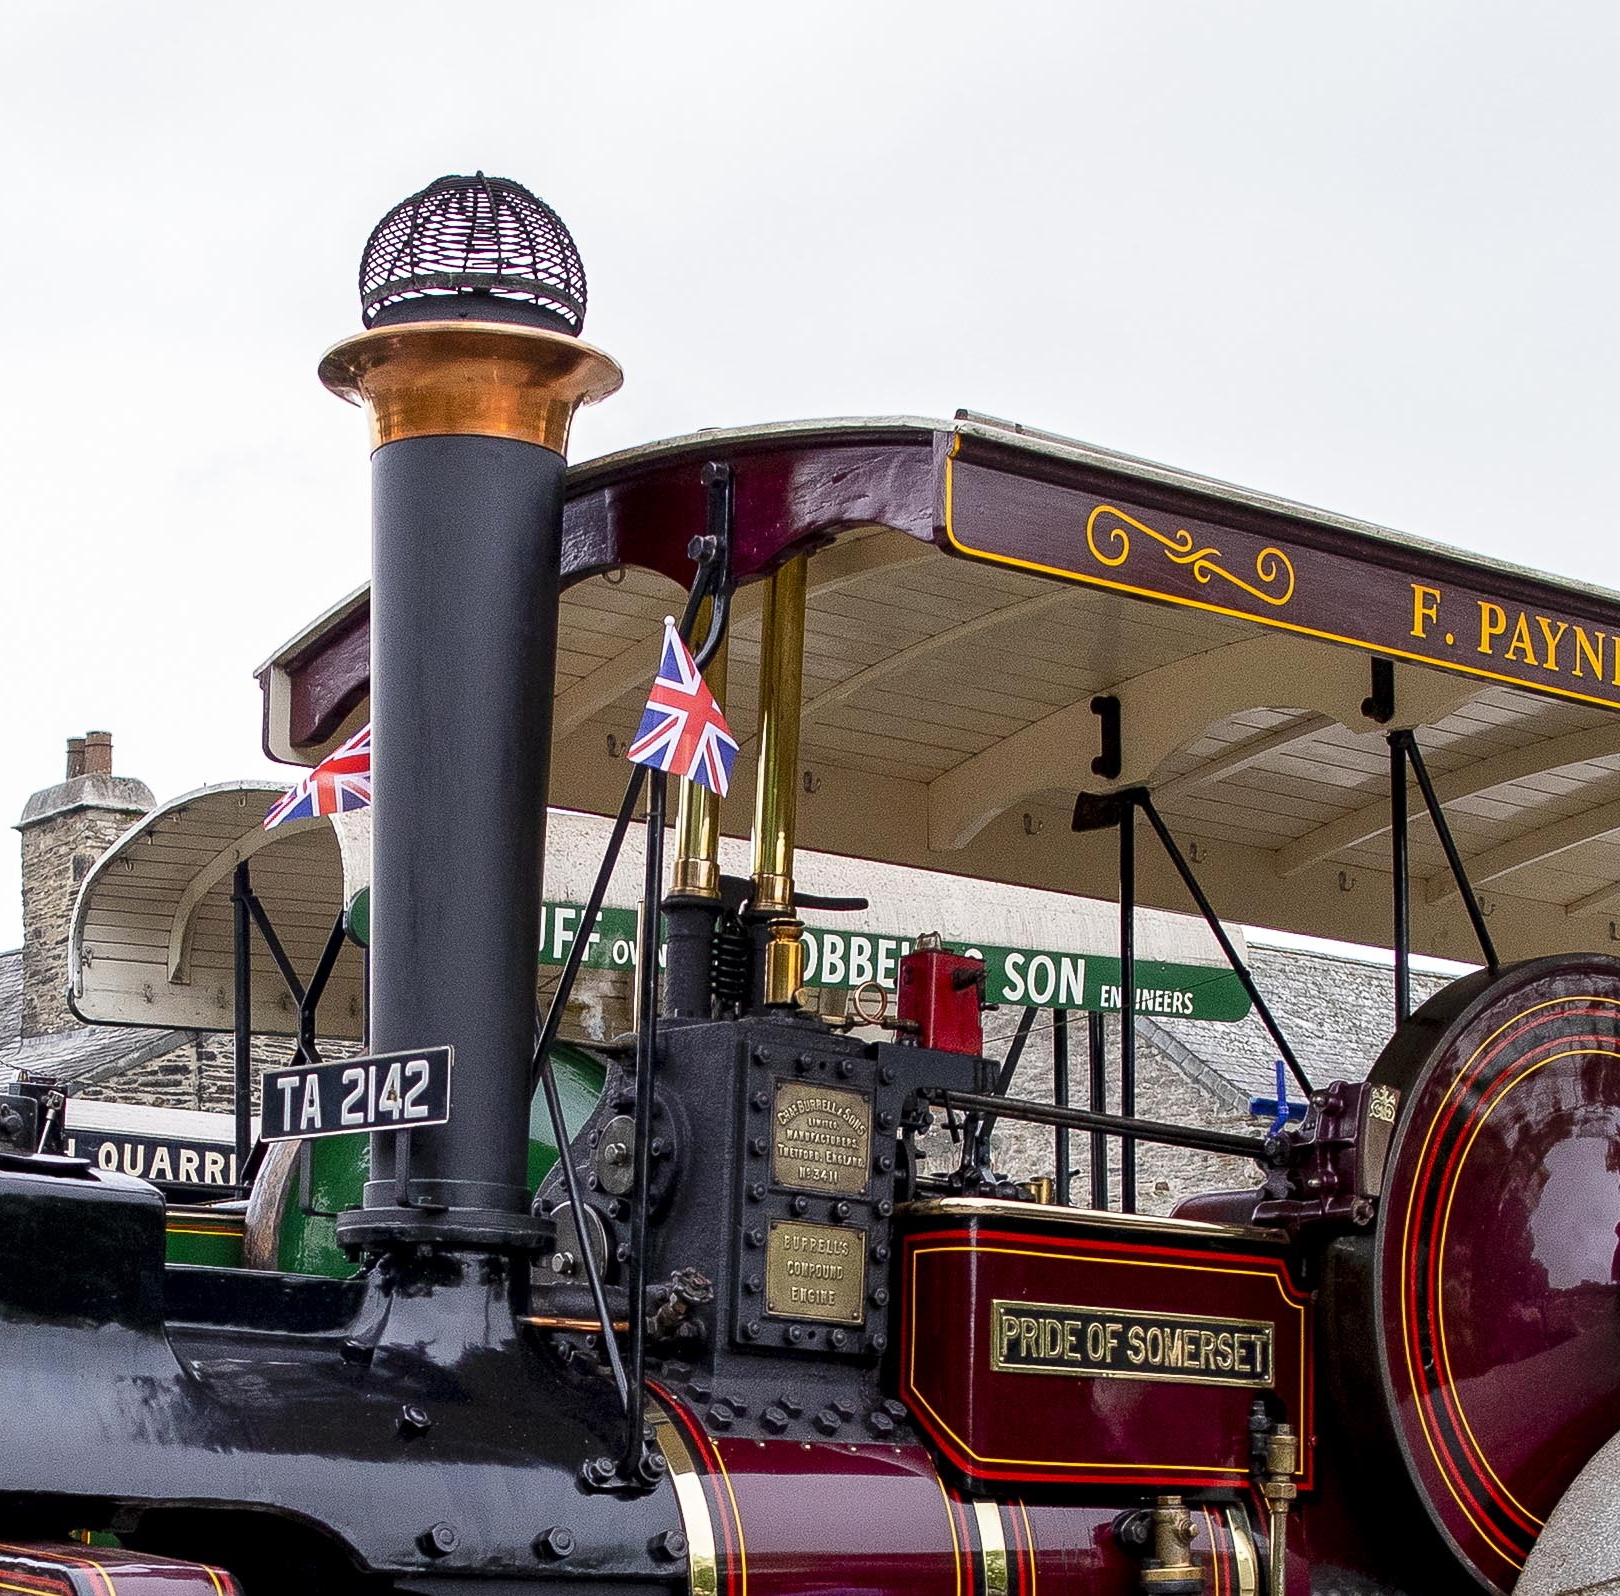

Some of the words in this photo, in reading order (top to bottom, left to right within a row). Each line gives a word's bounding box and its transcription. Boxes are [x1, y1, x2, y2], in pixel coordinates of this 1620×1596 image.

[1409, 582, 1455, 646] F.
[1002, 951, 1087, 1006] SON
[1099, 985, 1194, 1016] ENINEERS
[276, 1073, 322, 1132] TA
[340, 1059, 430, 1126] 2142
[842, 1107, 867, 1137] SONS
[786, 1260, 844, 1281] COMPOUND
[790, 1286, 837, 1307] ENGINE
[1001, 1315, 1082, 1361] PRIDE
[1086, 1322, 1124, 1363] OF
[1126, 1325, 1269, 1373] SOMERSET
